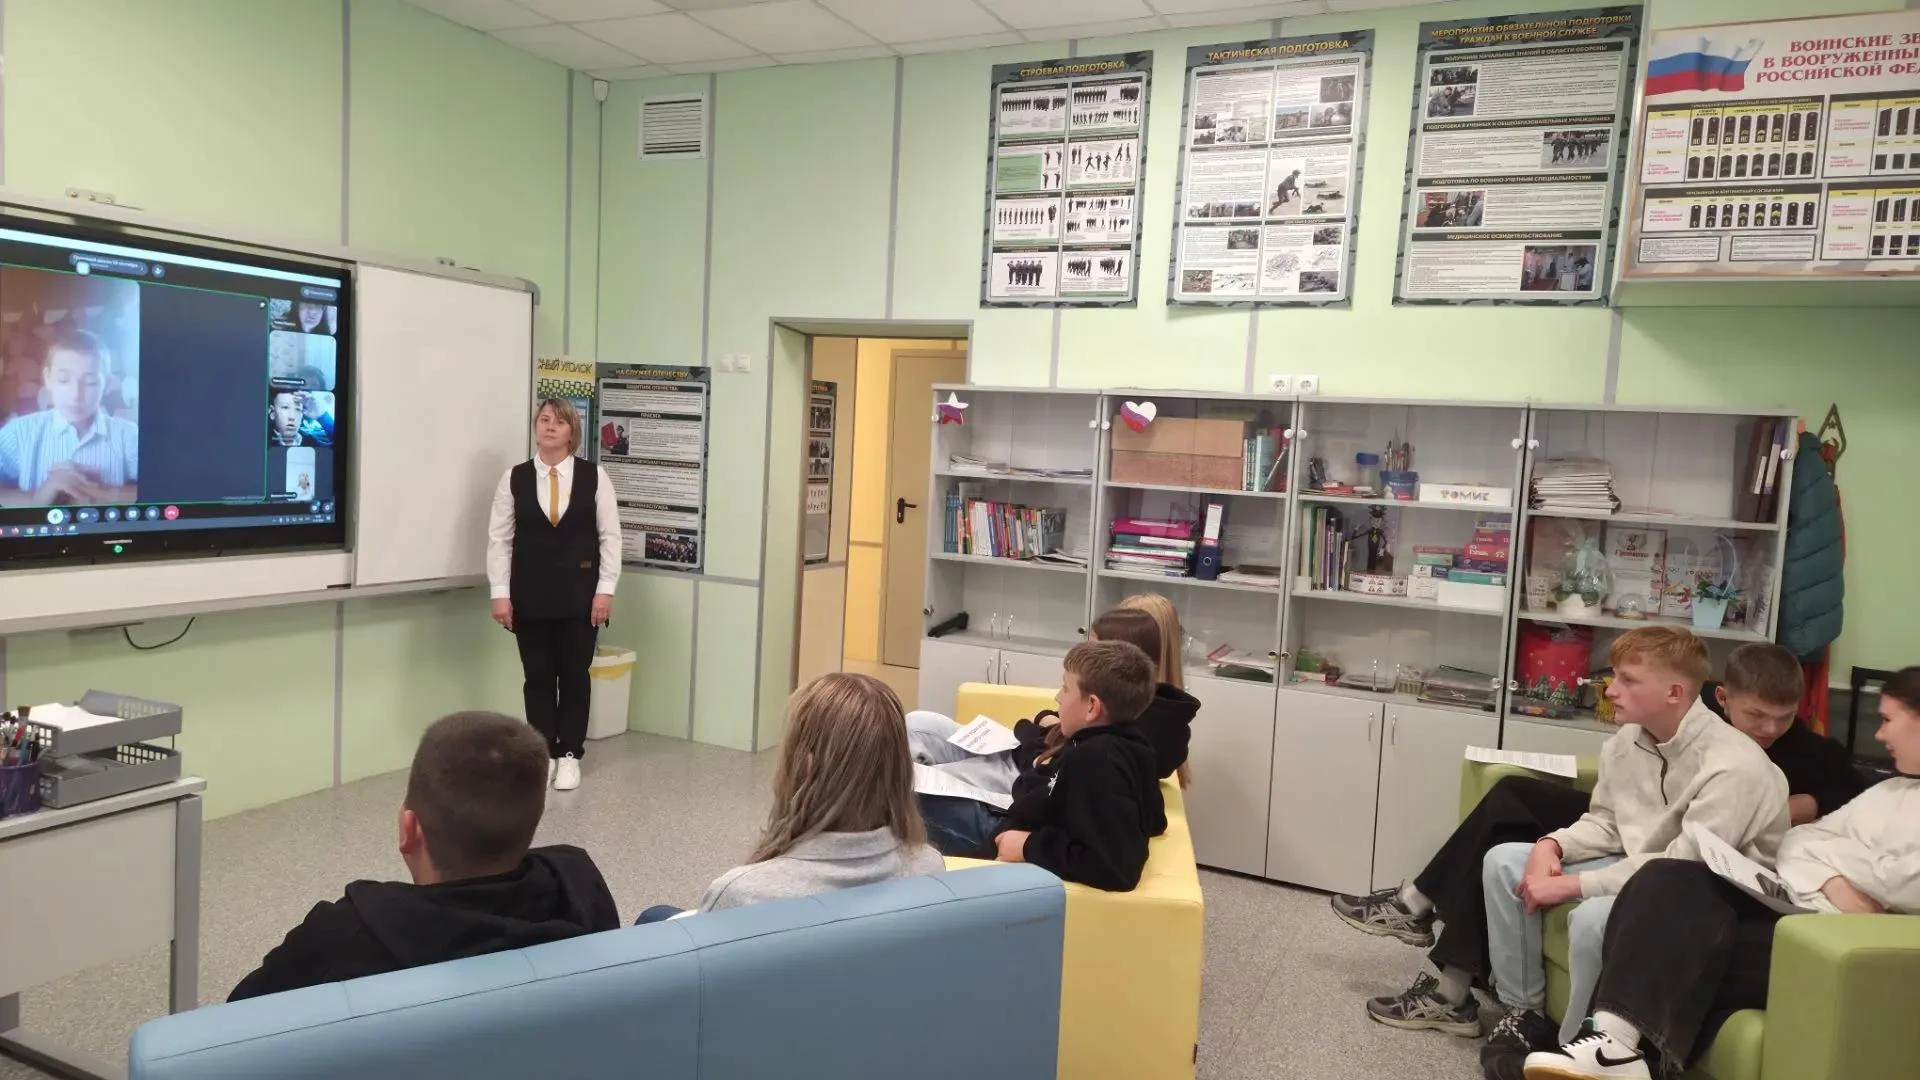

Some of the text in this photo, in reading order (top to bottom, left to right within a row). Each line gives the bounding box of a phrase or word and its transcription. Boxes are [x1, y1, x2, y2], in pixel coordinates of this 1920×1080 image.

[1431, 15, 1632, 38] МЕРОПРИЯТИЯ ОБЯЗАТЕЛЬНОЙ ПОДГОТОВКИ
[1459, 26, 1597, 44] ГРАЖДАН К ВОЕННОЙ СЛУЖБЕ
[1208, 39, 1350, 62] ТАКТИЧЕСКАЯ ПОДГОТОВКА
[1790, 34, 1893, 53] ВОИНСКИЕ
[1763, 48, 1920, 69] В ВООРУЖЕННЫ
[1020, 60, 1126, 78] СТРОЕВАЯ ПОДГОТОВКА
[1756, 63, 1883, 83] РОССИЙСКОЙ
[1432, 178, 1470, 186] ПОДГОТОВКА
[1534, 174, 1592, 183] СПЕЦИАЛЬНОСТЯМ
[1447, 231, 1563, 240] МЕДИЦИНСКОЕ ОСВИДЕТЕЛЬСТВОВАНИЕ
[560, 360, 593, 375] УГОЛОК
[625, 369, 651, 377] СЛУЖБЕ
[652, 370, 689, 378] ОТЕЧЕСТВУ
